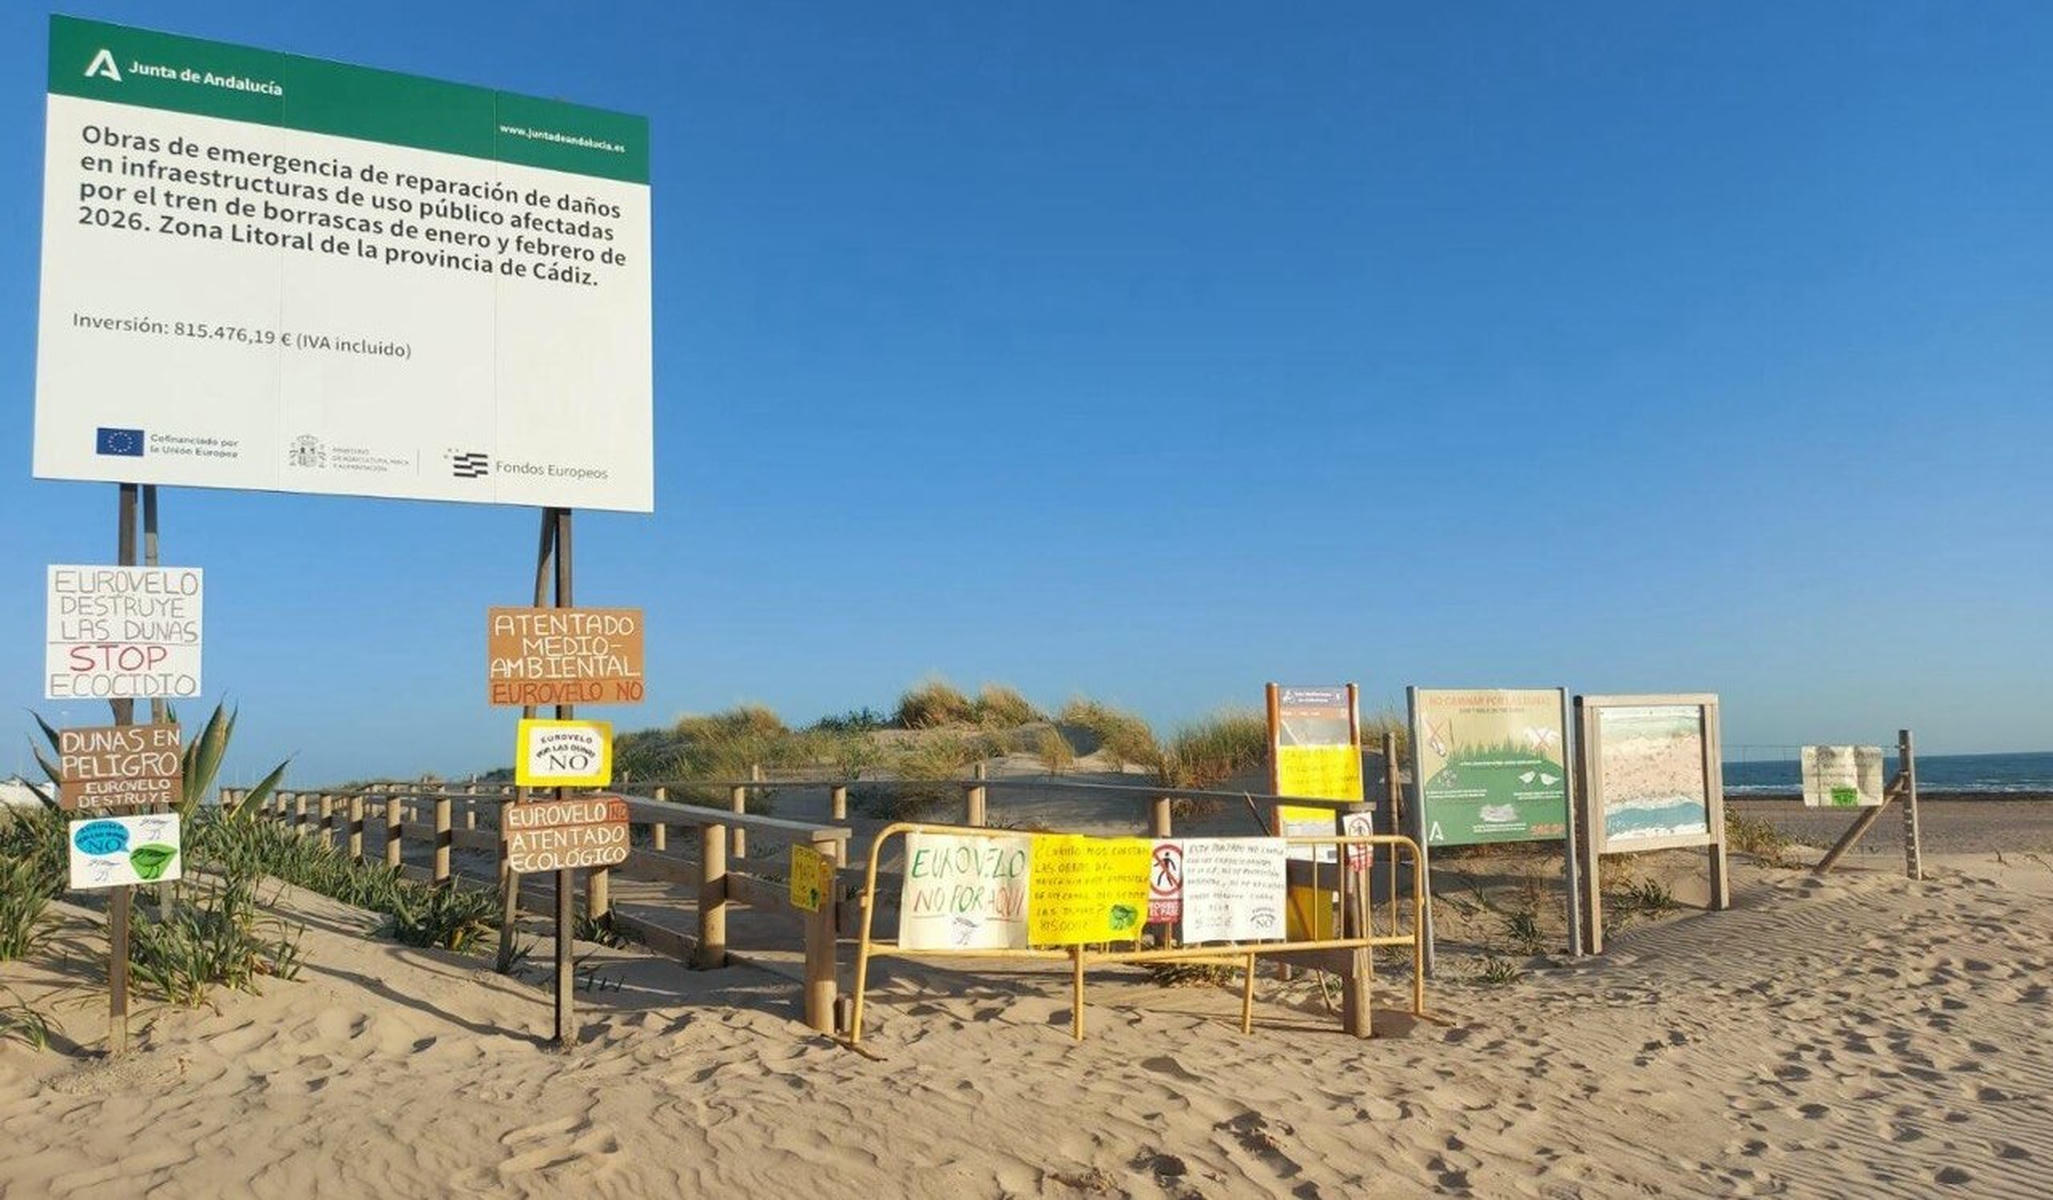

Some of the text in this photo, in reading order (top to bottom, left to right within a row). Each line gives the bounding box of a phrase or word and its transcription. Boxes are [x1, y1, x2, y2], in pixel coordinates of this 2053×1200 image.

[129, 61, 176, 79] Junta
[180, 69, 200, 83] de
[203, 72, 283, 96] Andalucía
[499, 125, 625, 153] www.juntadeandalucia.es
[82, 125, 622, 219] Obras de emergencia de reparación de daños
[81, 155, 614, 241] en infraestructuras de uso público afectadas
[80, 182, 627, 266] por el tren de borrascas de enero y febrero de
[78, 206, 598, 287] 2026. Zona Litoral de la provincia de Cádiz.
[73, 312, 411, 360] Inversión: 815.476,19 € (IVA incluido)
[150, 433, 239, 448] Cofinanciado por
[162, 446, 193, 456] Unión
[195, 447, 239, 459] Europea
[496, 460, 608, 480] Fondos Europeos
[55, 571, 199, 596] EUROVELO
[61, 597, 186, 618] DESTRUYE
[61, 619, 199, 643] LAS DUNAS
[495, 613, 635, 637] ATENTADO
[70, 644, 167, 672] STOP
[523, 637, 623, 657] MEDIO-
[491, 655, 641, 679] AMBIENTAL
[50, 673, 197, 698] ECOCIDIO
[493, 683, 643, 704] EUROVELO NO
[62, 729, 180, 753] DUNAS EN
[541, 734, 592, 744] EUROVELO
[553, 744, 569, 752] LAS
[62, 752, 178, 779] PELIGRO
[549, 755, 588, 770] NO
[86, 779, 171, 795] EUROVELO
[78, 792, 171, 808] DESTRUYE
[509, 803, 607, 827] EUROVELO
[511, 826, 625, 850] ATENTADO
[511, 847, 626, 872] ECOLÓGICO
[914, 887, 945, 912] NO
